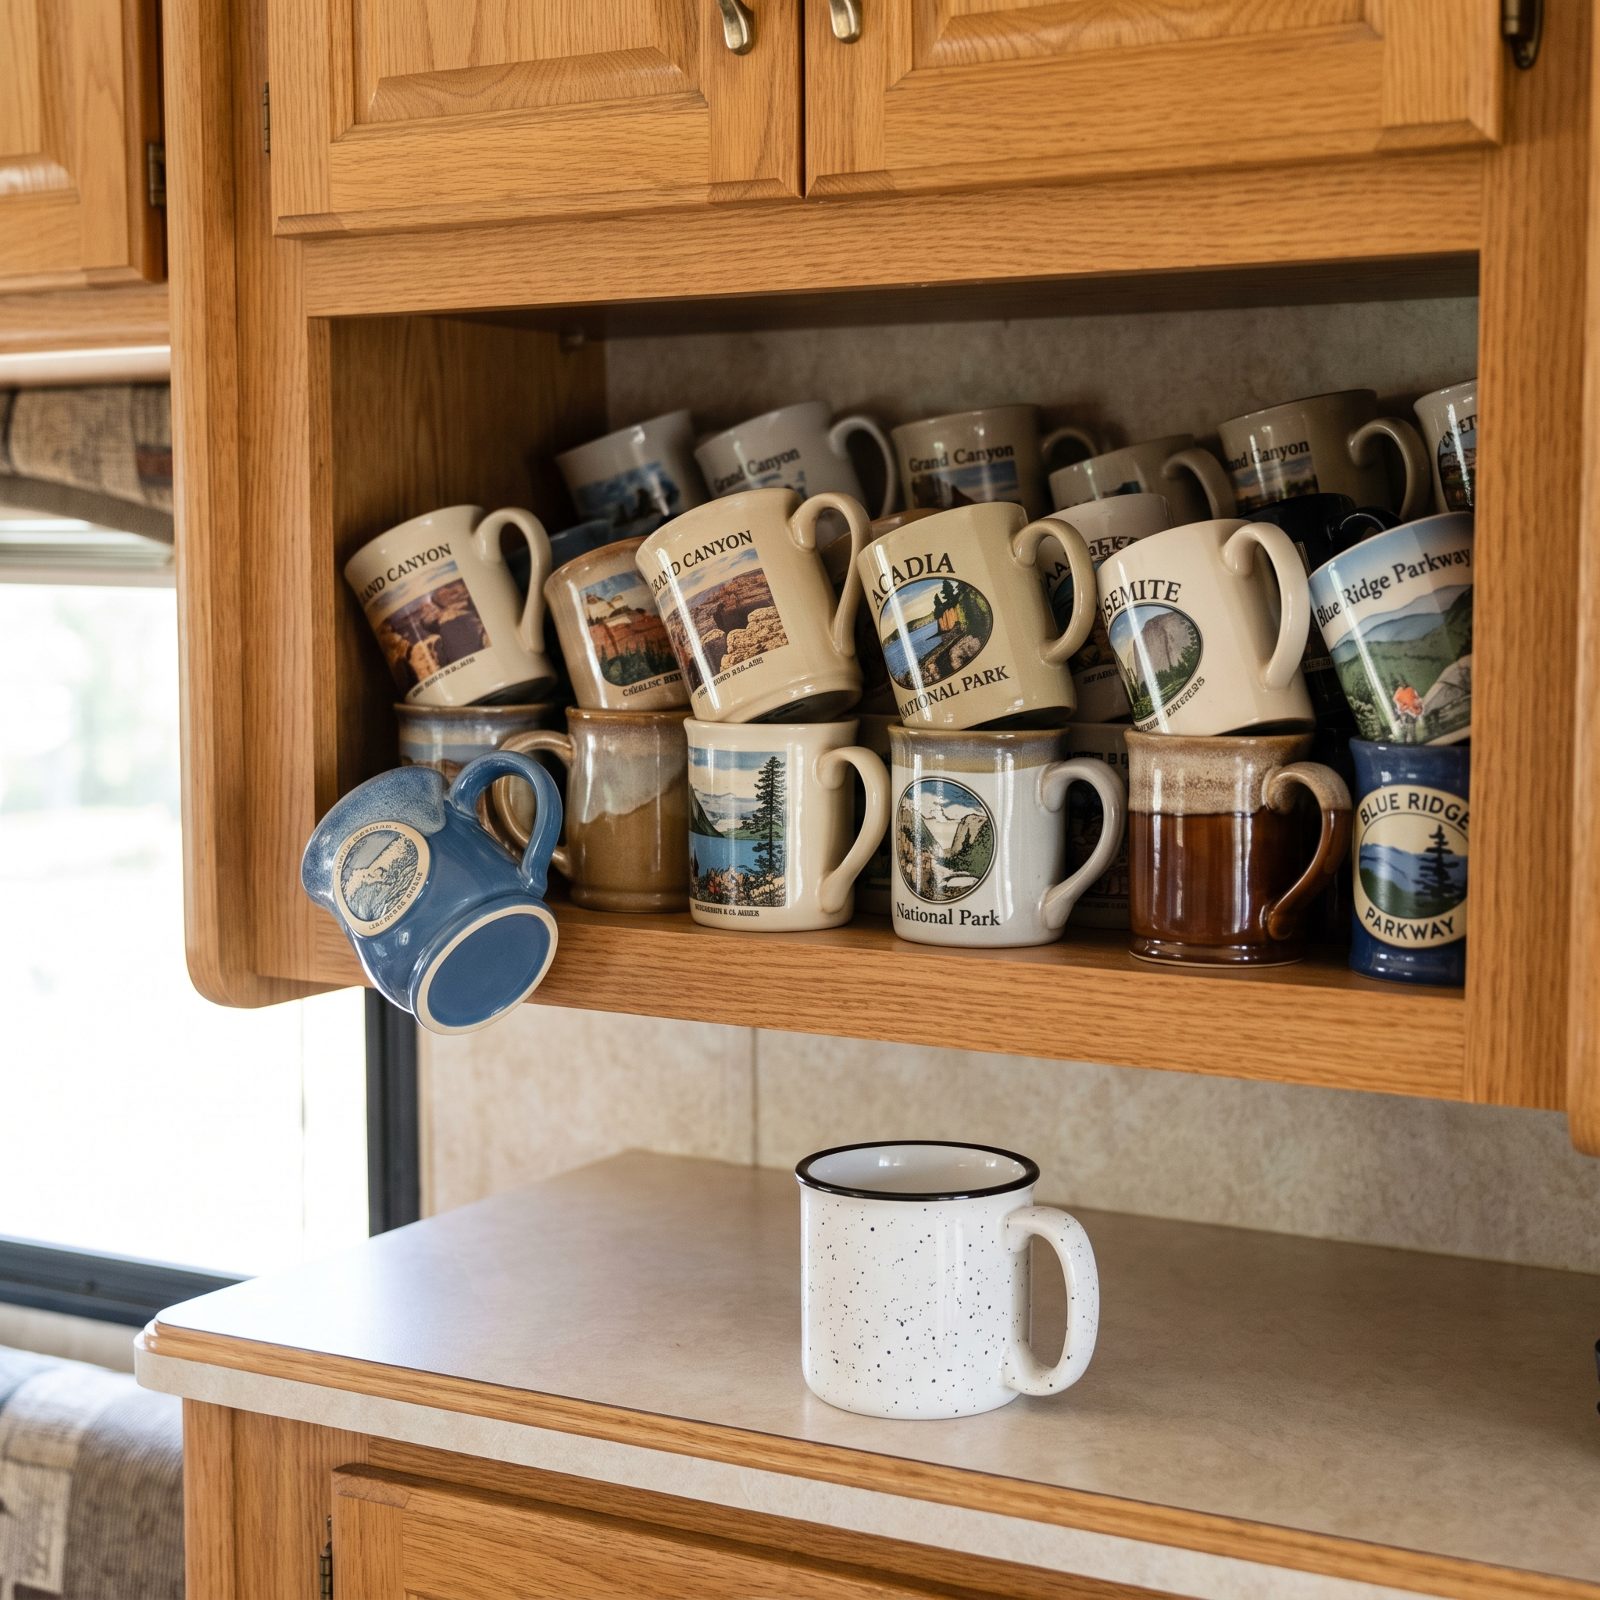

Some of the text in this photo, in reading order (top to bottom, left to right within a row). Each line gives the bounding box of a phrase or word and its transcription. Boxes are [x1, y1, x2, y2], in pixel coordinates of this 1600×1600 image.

[747, 448, 801, 476] Canyon
[909, 445, 1015, 472] Grand Canyon
[1228, 441, 1311, 471] and Canyon
[361, 543, 453, 602] AND CANYON
[651, 530, 754, 597] RAND CANYON
[872, 552, 956, 610] ACADIA
[1316, 548, 1471, 628] Blue Ridge Parkway
[900, 665, 1010, 721] NATIONAL PARK
[1359, 793, 1470, 831] BLUE RIDGE
[896, 901, 1001, 927] National Park
[1365, 907, 1455, 941] PARKWAY
